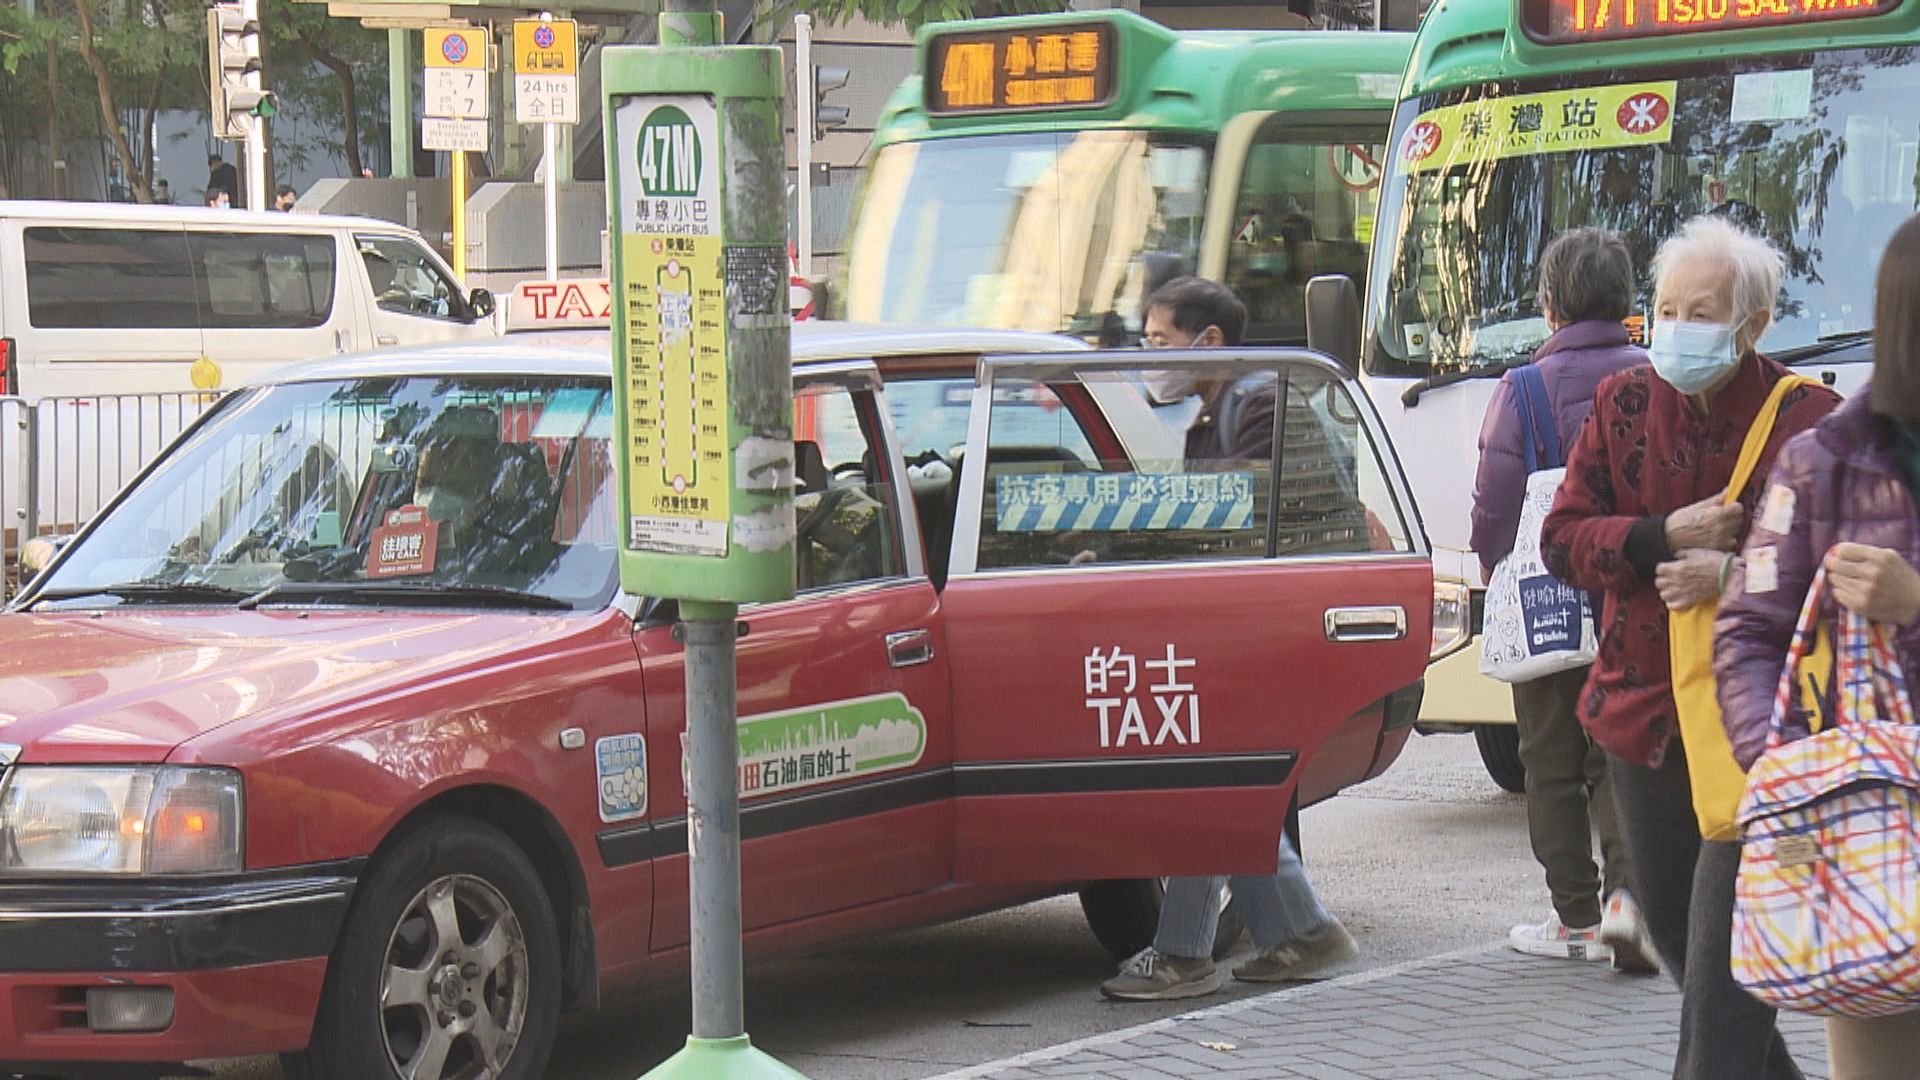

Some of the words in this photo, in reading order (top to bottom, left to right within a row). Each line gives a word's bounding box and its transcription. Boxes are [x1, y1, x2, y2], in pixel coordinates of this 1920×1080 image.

[464, 72, 474, 89] 7
[523, 80, 542, 93] 24
[546, 80, 568, 93] hrs
[464, 97, 474, 113] 7
[529, 97, 564, 117] 全日
[1461, 97, 1599, 141] 柴灣站
[1534, 128, 1601, 146] STATION
[641, 124, 697, 192] 47M
[636, 200, 708, 222] 專線小巴
[635, 223, 666, 234] PUBLIC
[667, 224, 690, 234] LIGHT
[692, 224, 709, 235] BUS
[1000, 475, 1120, 505] 抗疫專用
[1129, 473, 1250, 505] 必須預約
[382, 551, 395, 561] ON
[397, 549, 420, 560] CALL
[1084, 643, 1197, 694] 的士
[1086, 694, 1200, 747] TAXI
[737, 745, 852, 792] 田石油氣的士
